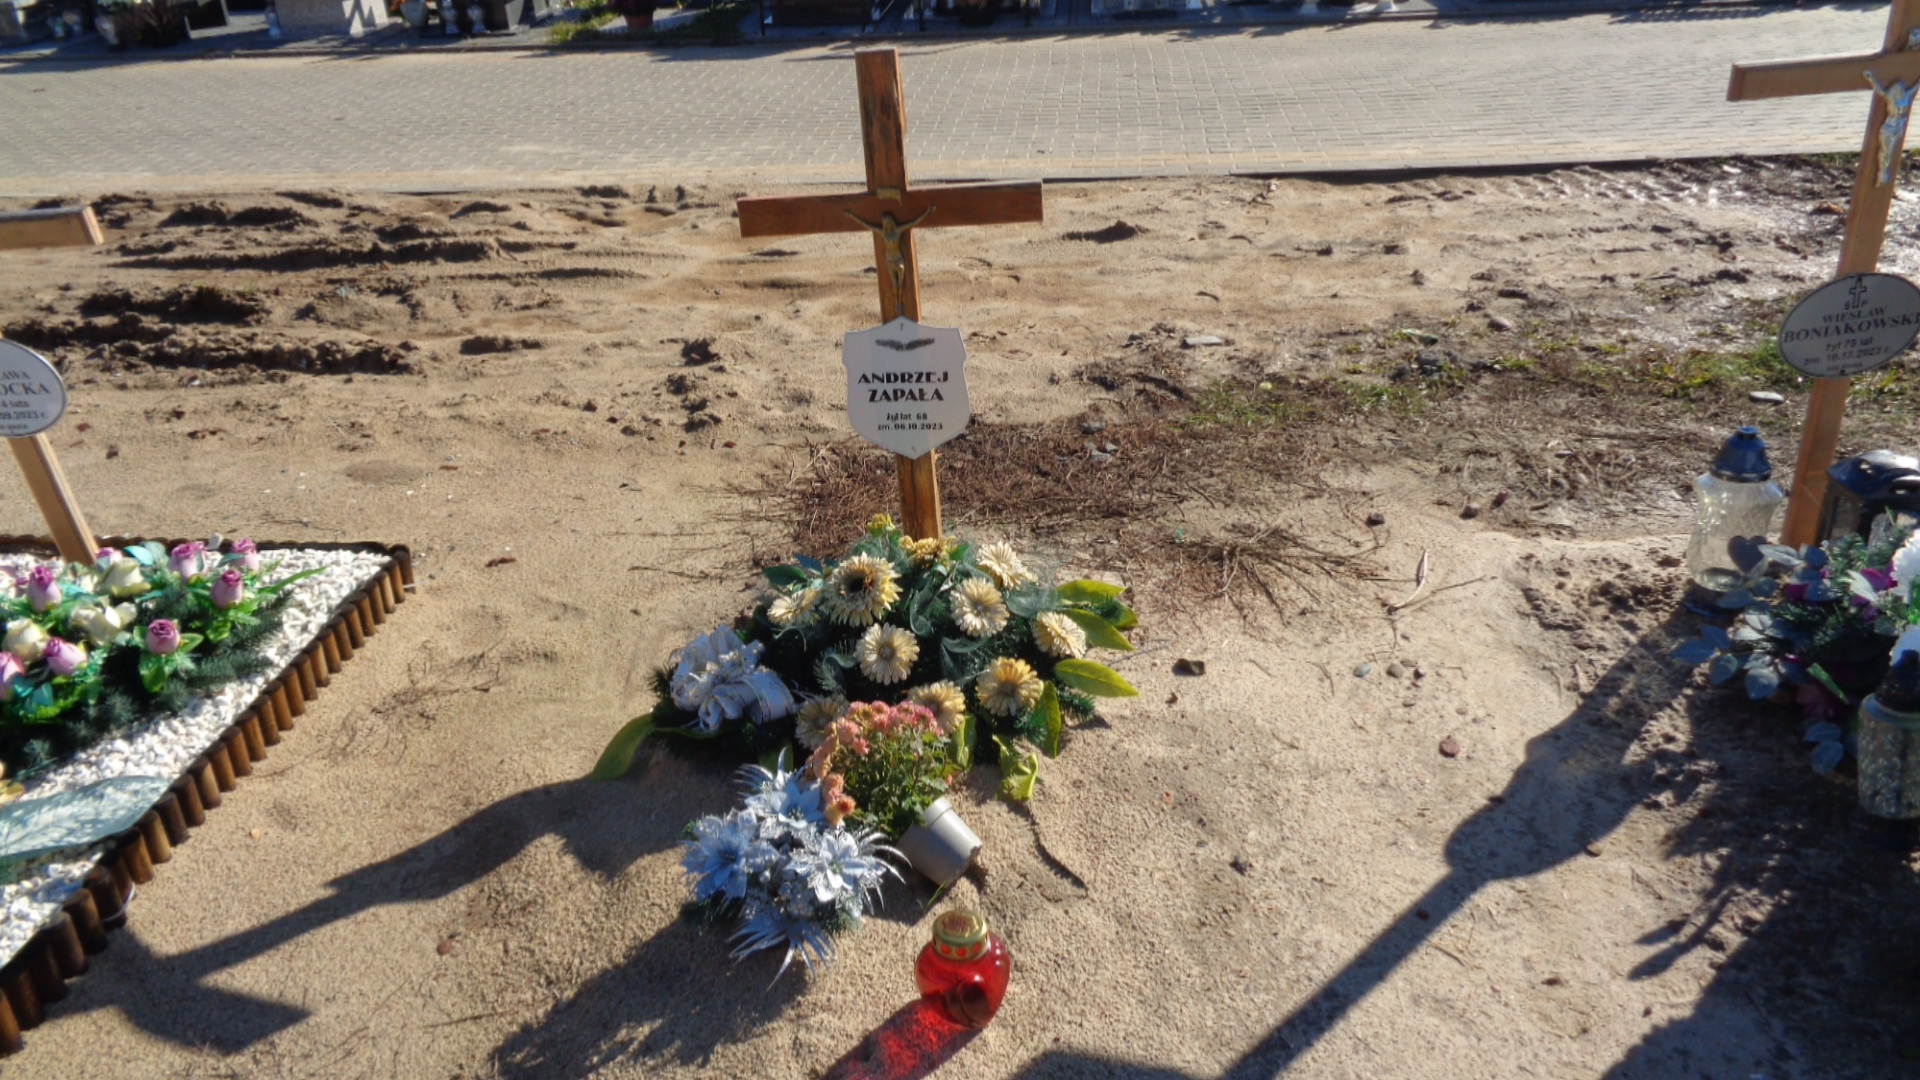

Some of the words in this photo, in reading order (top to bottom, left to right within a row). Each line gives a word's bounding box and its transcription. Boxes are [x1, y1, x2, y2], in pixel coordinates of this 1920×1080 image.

[1823, 306, 1887, 323] WIESŁAW
[1783, 312, 1920, 342] BONIAKOWSKI
[0, 370, 31, 381] AWA
[858, 371, 949, 384] ANDRZEJ
[867, 388, 944, 403] ZAPAŁA
[900, 412, 911, 421] lat
[916, 412, 928, 421] 68
